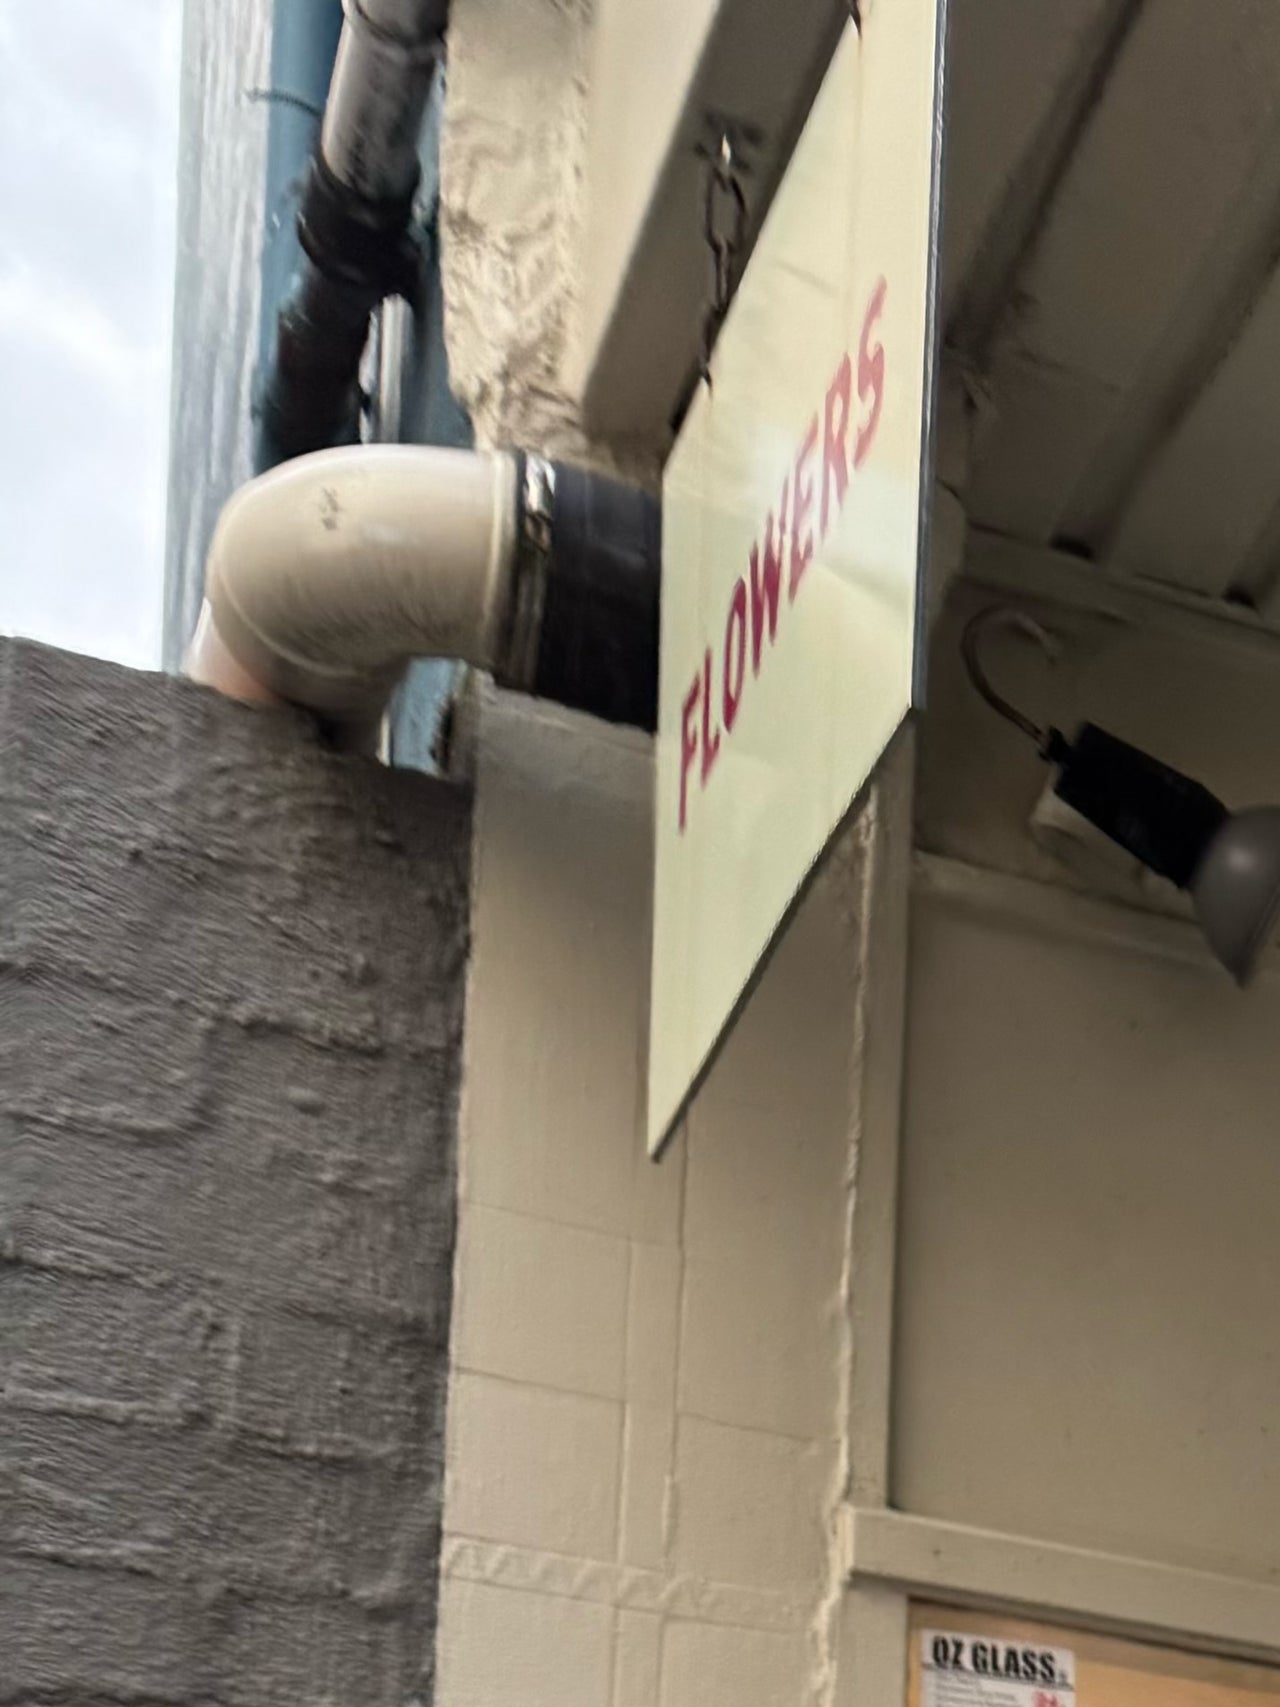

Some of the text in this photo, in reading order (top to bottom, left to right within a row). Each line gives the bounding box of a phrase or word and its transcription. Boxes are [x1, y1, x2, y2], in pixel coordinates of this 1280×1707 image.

[679, 275, 887, 829] FLOWERS
[931, 1635, 1056, 1684] OZ GLASS
